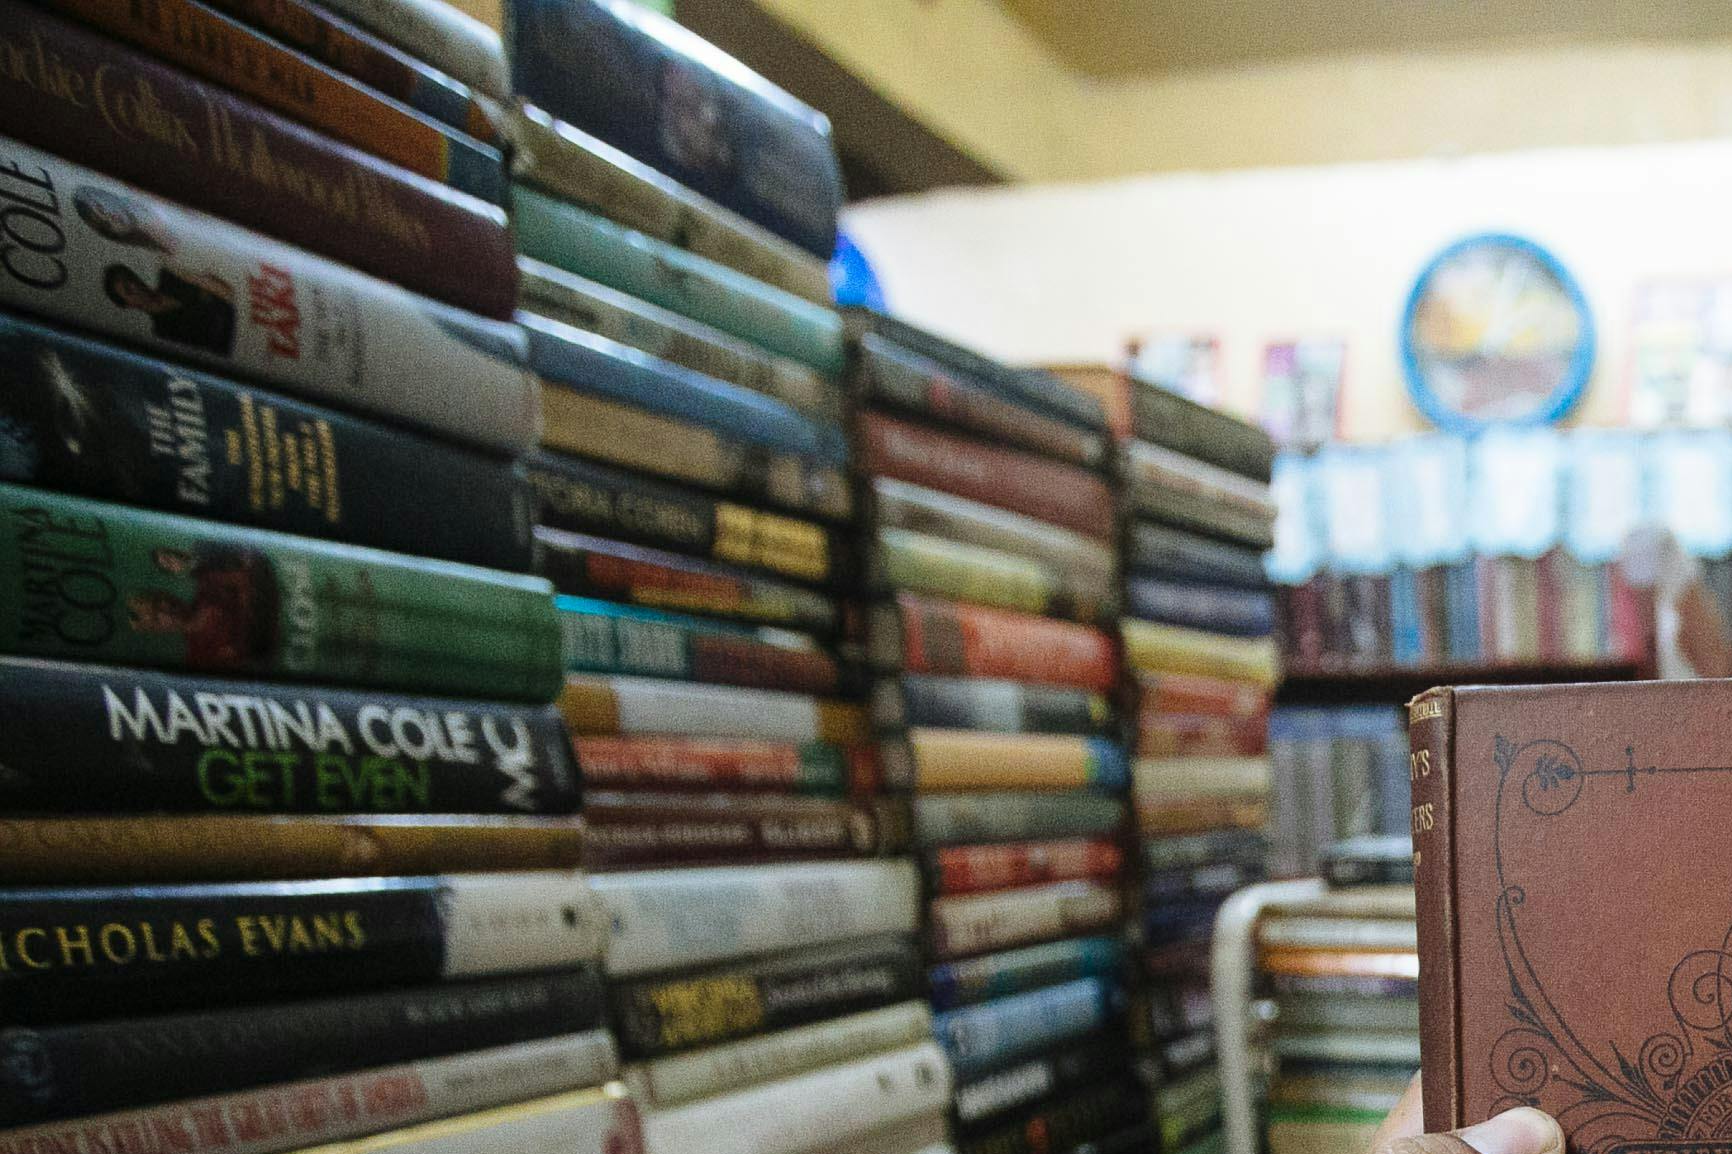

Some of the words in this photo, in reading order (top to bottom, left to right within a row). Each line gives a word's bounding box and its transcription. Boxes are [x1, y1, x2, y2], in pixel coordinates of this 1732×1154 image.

[145, 400, 177, 456] THE
[167, 376, 209, 504] FAMILY
[52, 517, 117, 645] COLE
[102, 684, 356, 757] MARTINA
[357, 703, 481, 765] COLE
[199, 749, 299, 808] GET
[316, 753, 431, 809] EVEN
[235, 909, 366, 958] EVANS
